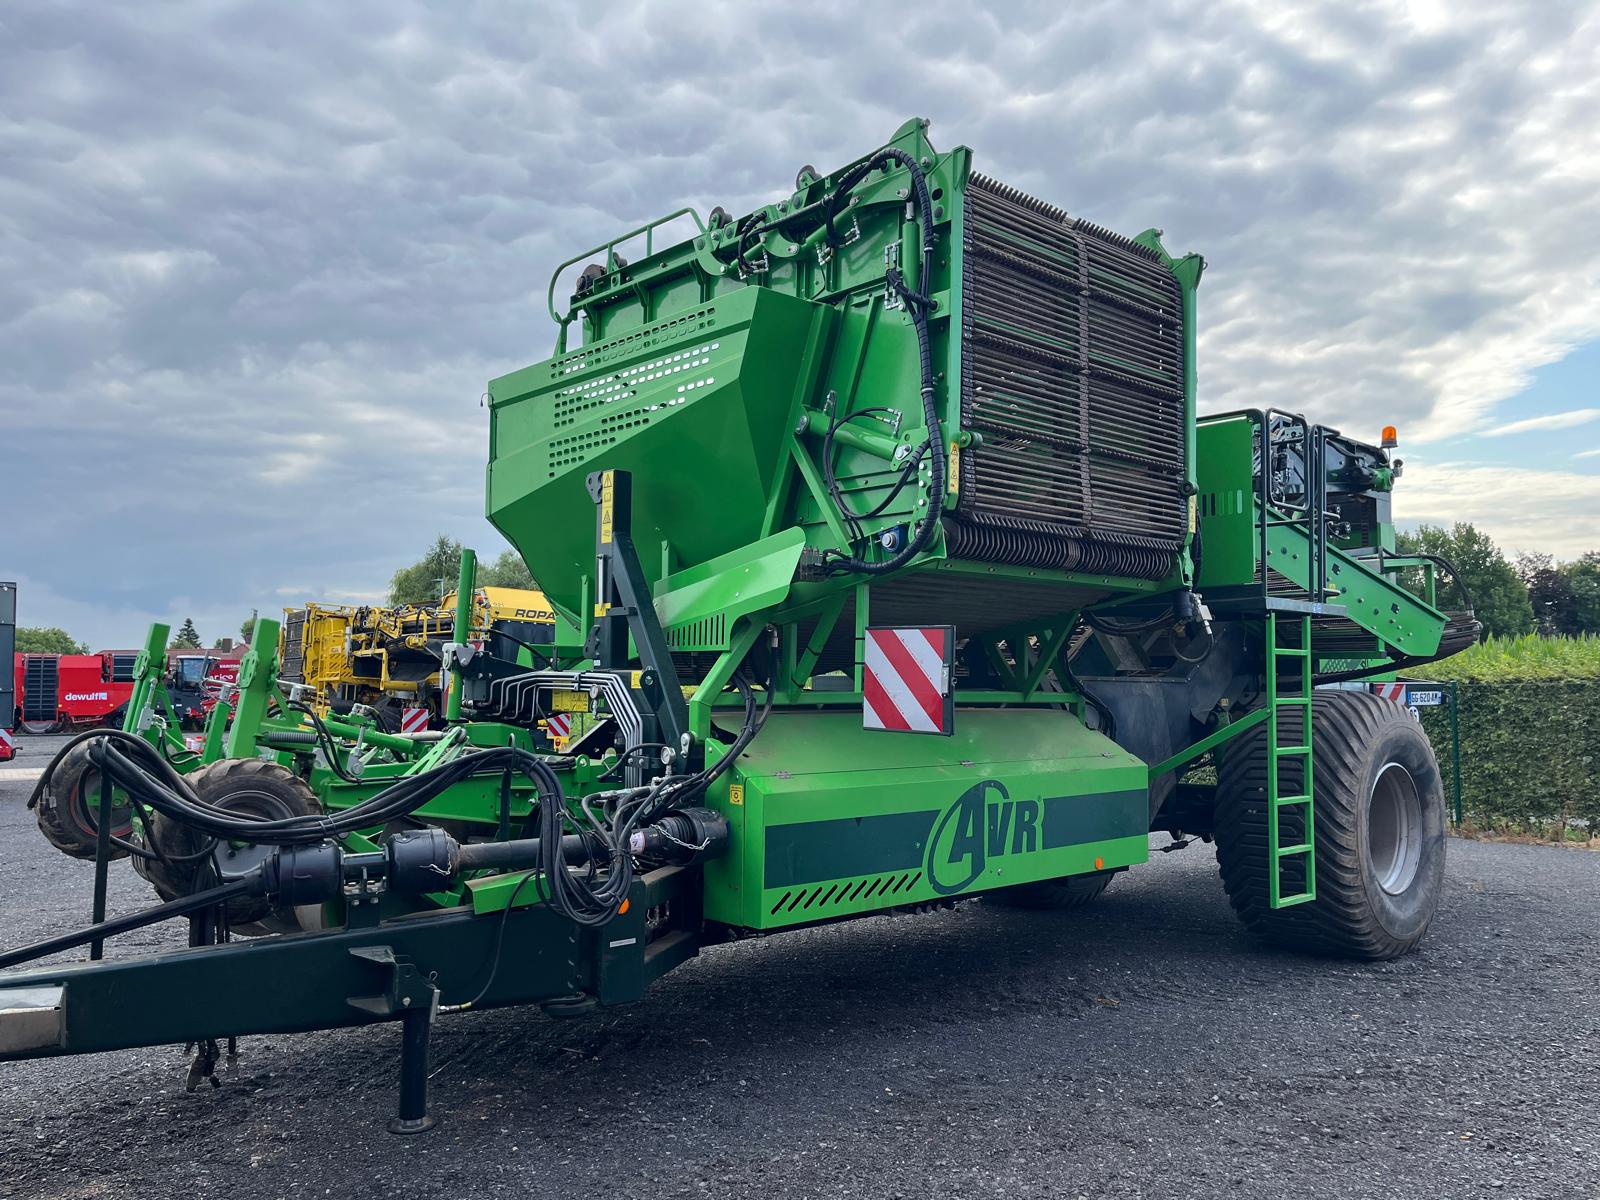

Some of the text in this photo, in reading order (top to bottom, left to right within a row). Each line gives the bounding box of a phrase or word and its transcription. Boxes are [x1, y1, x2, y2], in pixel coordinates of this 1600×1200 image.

[515, 609, 555, 620] ROPA
[65, 692, 100, 701] dewulf
[927, 779, 1039, 895] AVR
